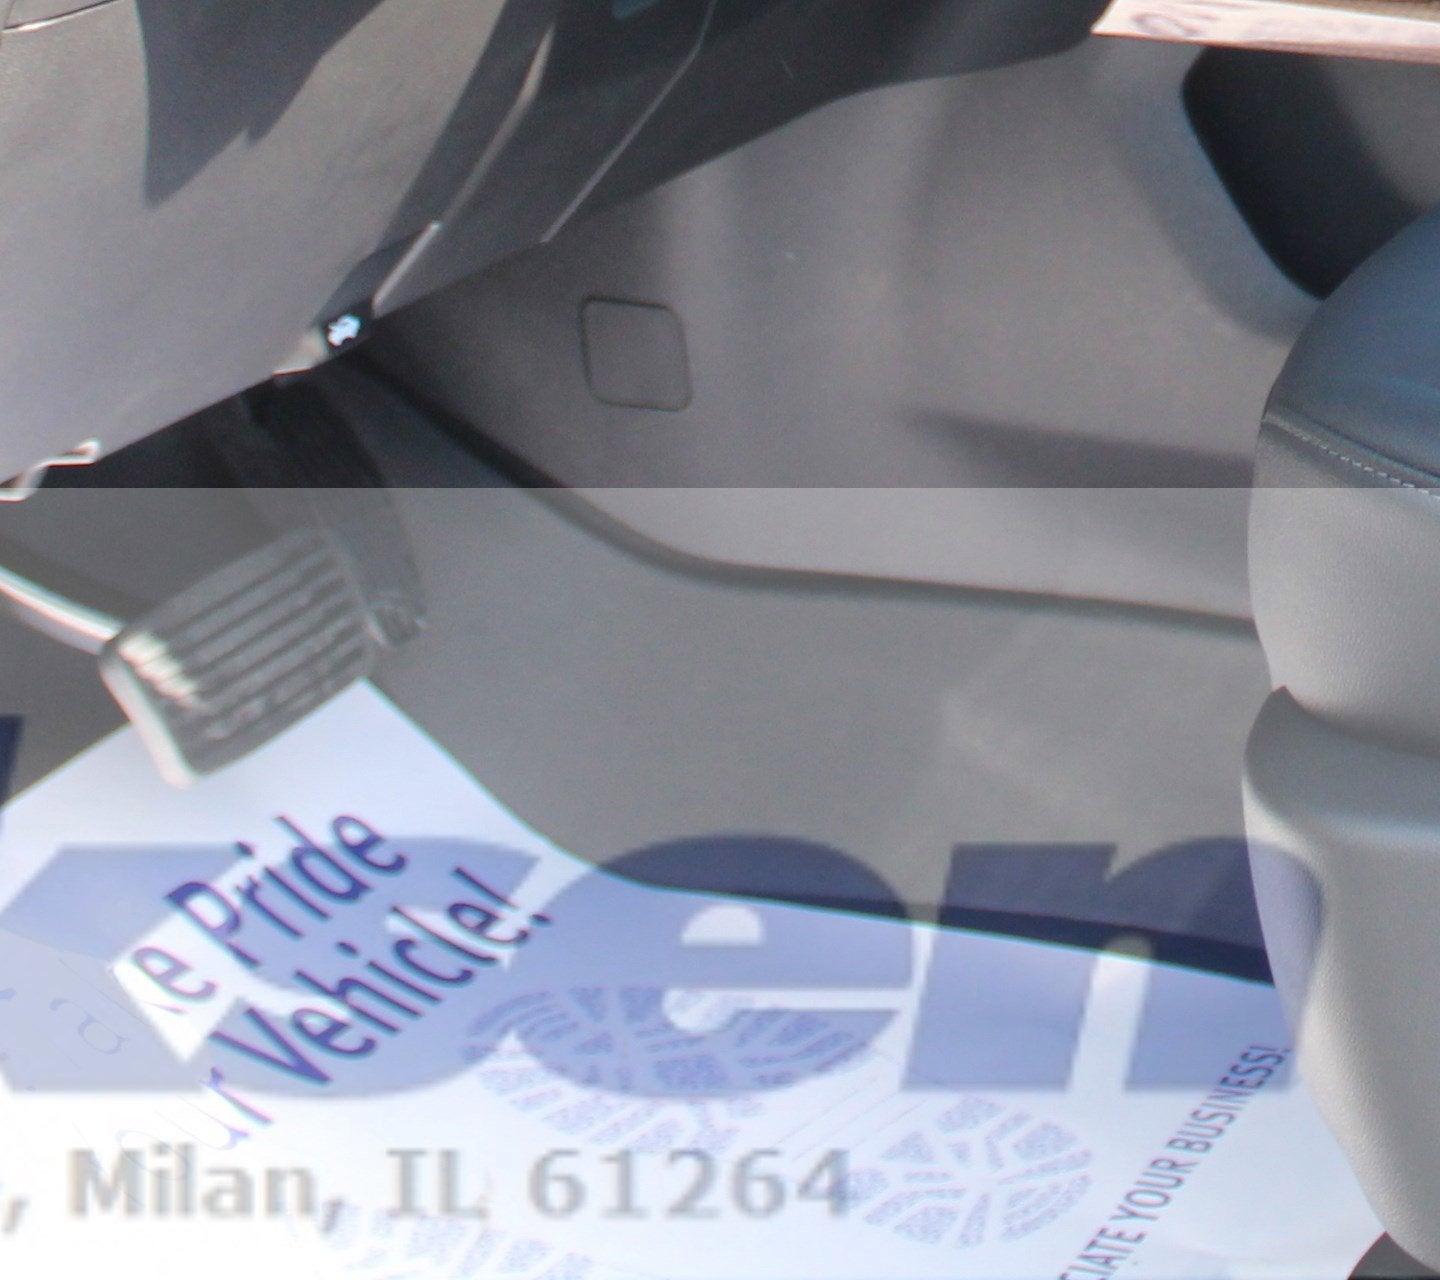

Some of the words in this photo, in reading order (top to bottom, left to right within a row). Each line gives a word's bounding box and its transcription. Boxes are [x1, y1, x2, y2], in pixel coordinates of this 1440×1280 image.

[165, 813, 408, 968] Pride
[208, 866, 553, 1086] Vehicle!
[1059, 1226, 1148, 1280] IATE
[1110, 1156, 1200, 1224] YOUR
[1166, 1043, 1292, 1156] BUSINESS!
